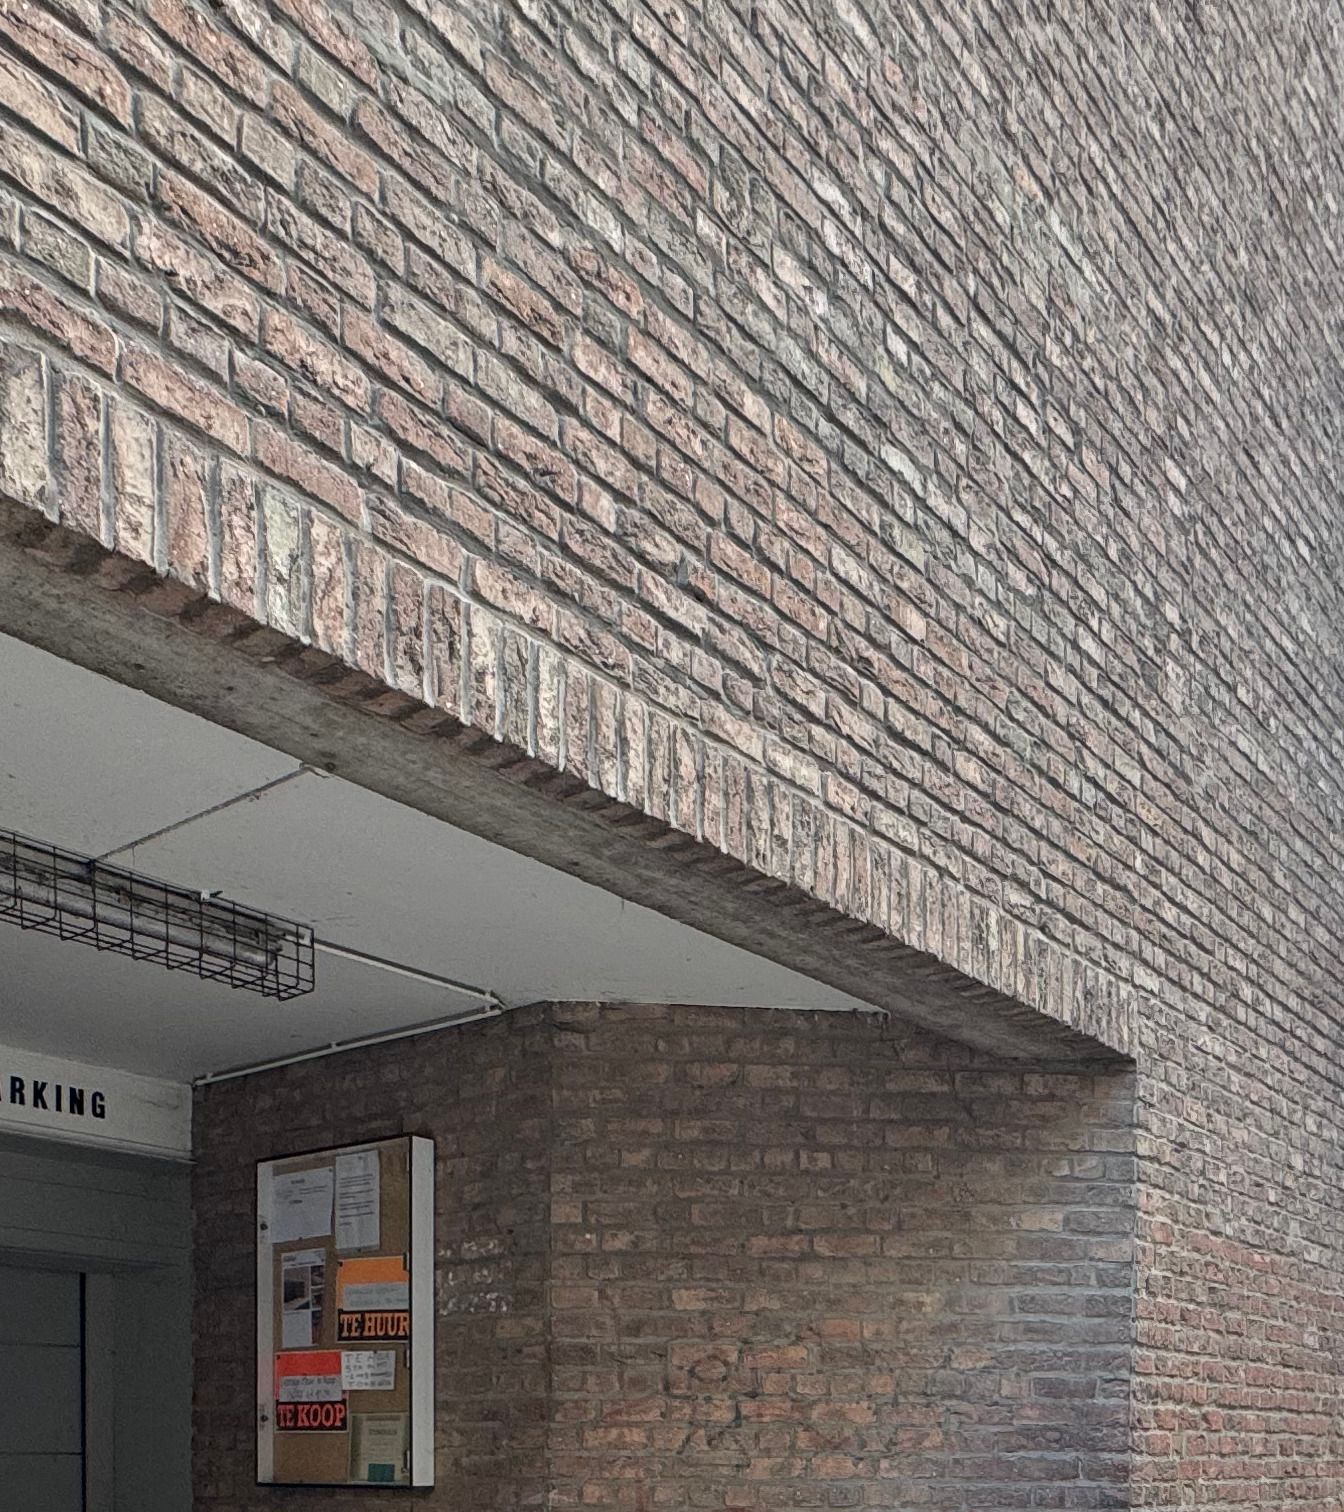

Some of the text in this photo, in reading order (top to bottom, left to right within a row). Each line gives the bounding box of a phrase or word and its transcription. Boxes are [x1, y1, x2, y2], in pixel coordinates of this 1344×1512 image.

[341, 1312, 408, 1336] TE HUUR
[278, 1403, 345, 1426] TE KOOP
